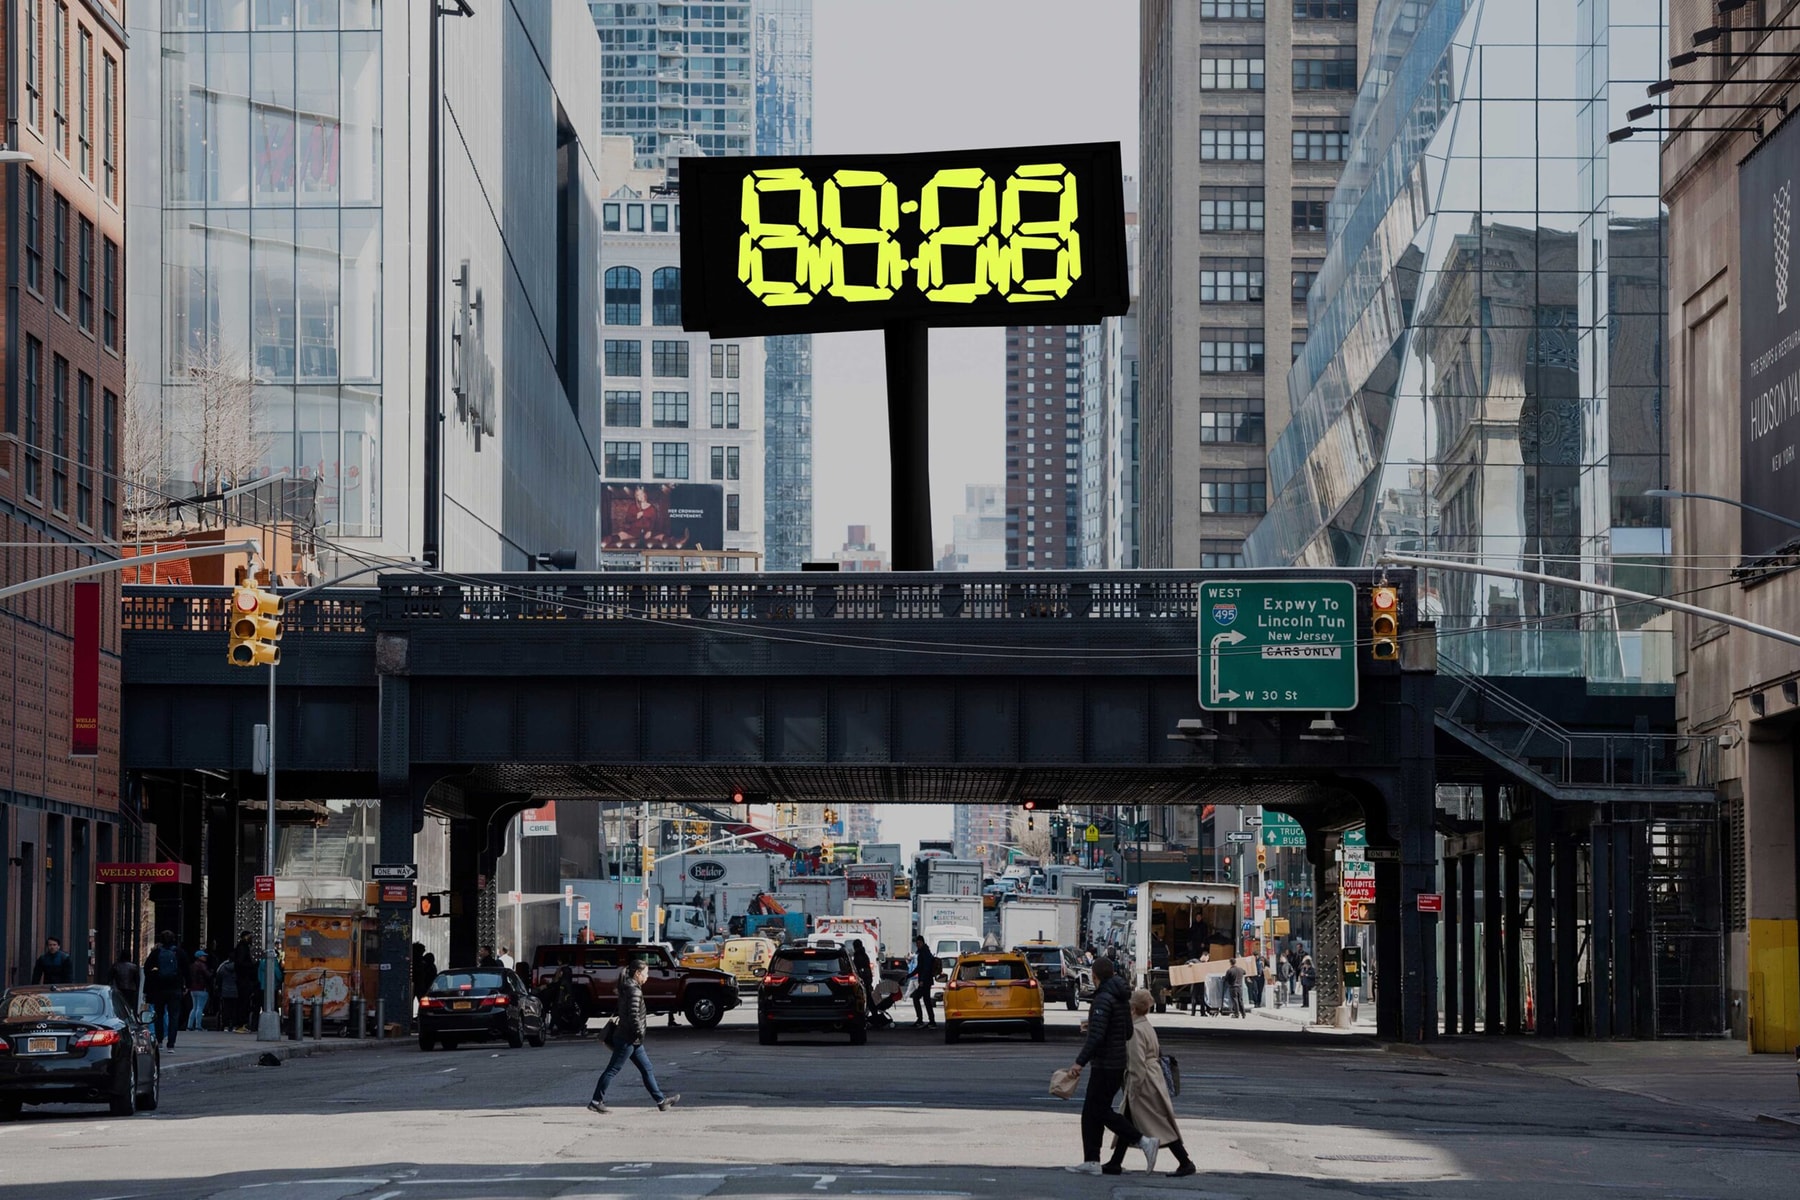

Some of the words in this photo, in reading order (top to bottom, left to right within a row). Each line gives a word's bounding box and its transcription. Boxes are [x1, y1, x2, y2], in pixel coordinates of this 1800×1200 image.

[1750, 359, 1759, 378] THE
[1759, 347, 1774, 372] SHOPS
[1750, 379, 1787, 442] HUDSON
[1771, 452, 1782, 473] NEW
[1782, 444, 1795, 466] YORK
[1208, 588, 1242, 598] WEST
[1263, 598, 1317, 613] Expwy
[1322, 598, 1339, 610] To
[1214, 610, 1235, 620] 495
[1258, 615, 1313, 627] Lincoln
[1318, 615, 1345, 628] Tun
[1268, 631, 1292, 641] New
[1296, 631, 1335, 643] Jersey
[1266, 647, 1300, 657] CARS
[1304, 647, 1336, 656] ONLY
[1245, 691, 1255, 700] W
[1262, 691, 1278, 700] 30
[1285, 690, 1298, 700] St
[1277, 813, 1294, 822] Ne
[100, 868, 136, 876] WELLS
[139, 868, 174, 876] FARGO
